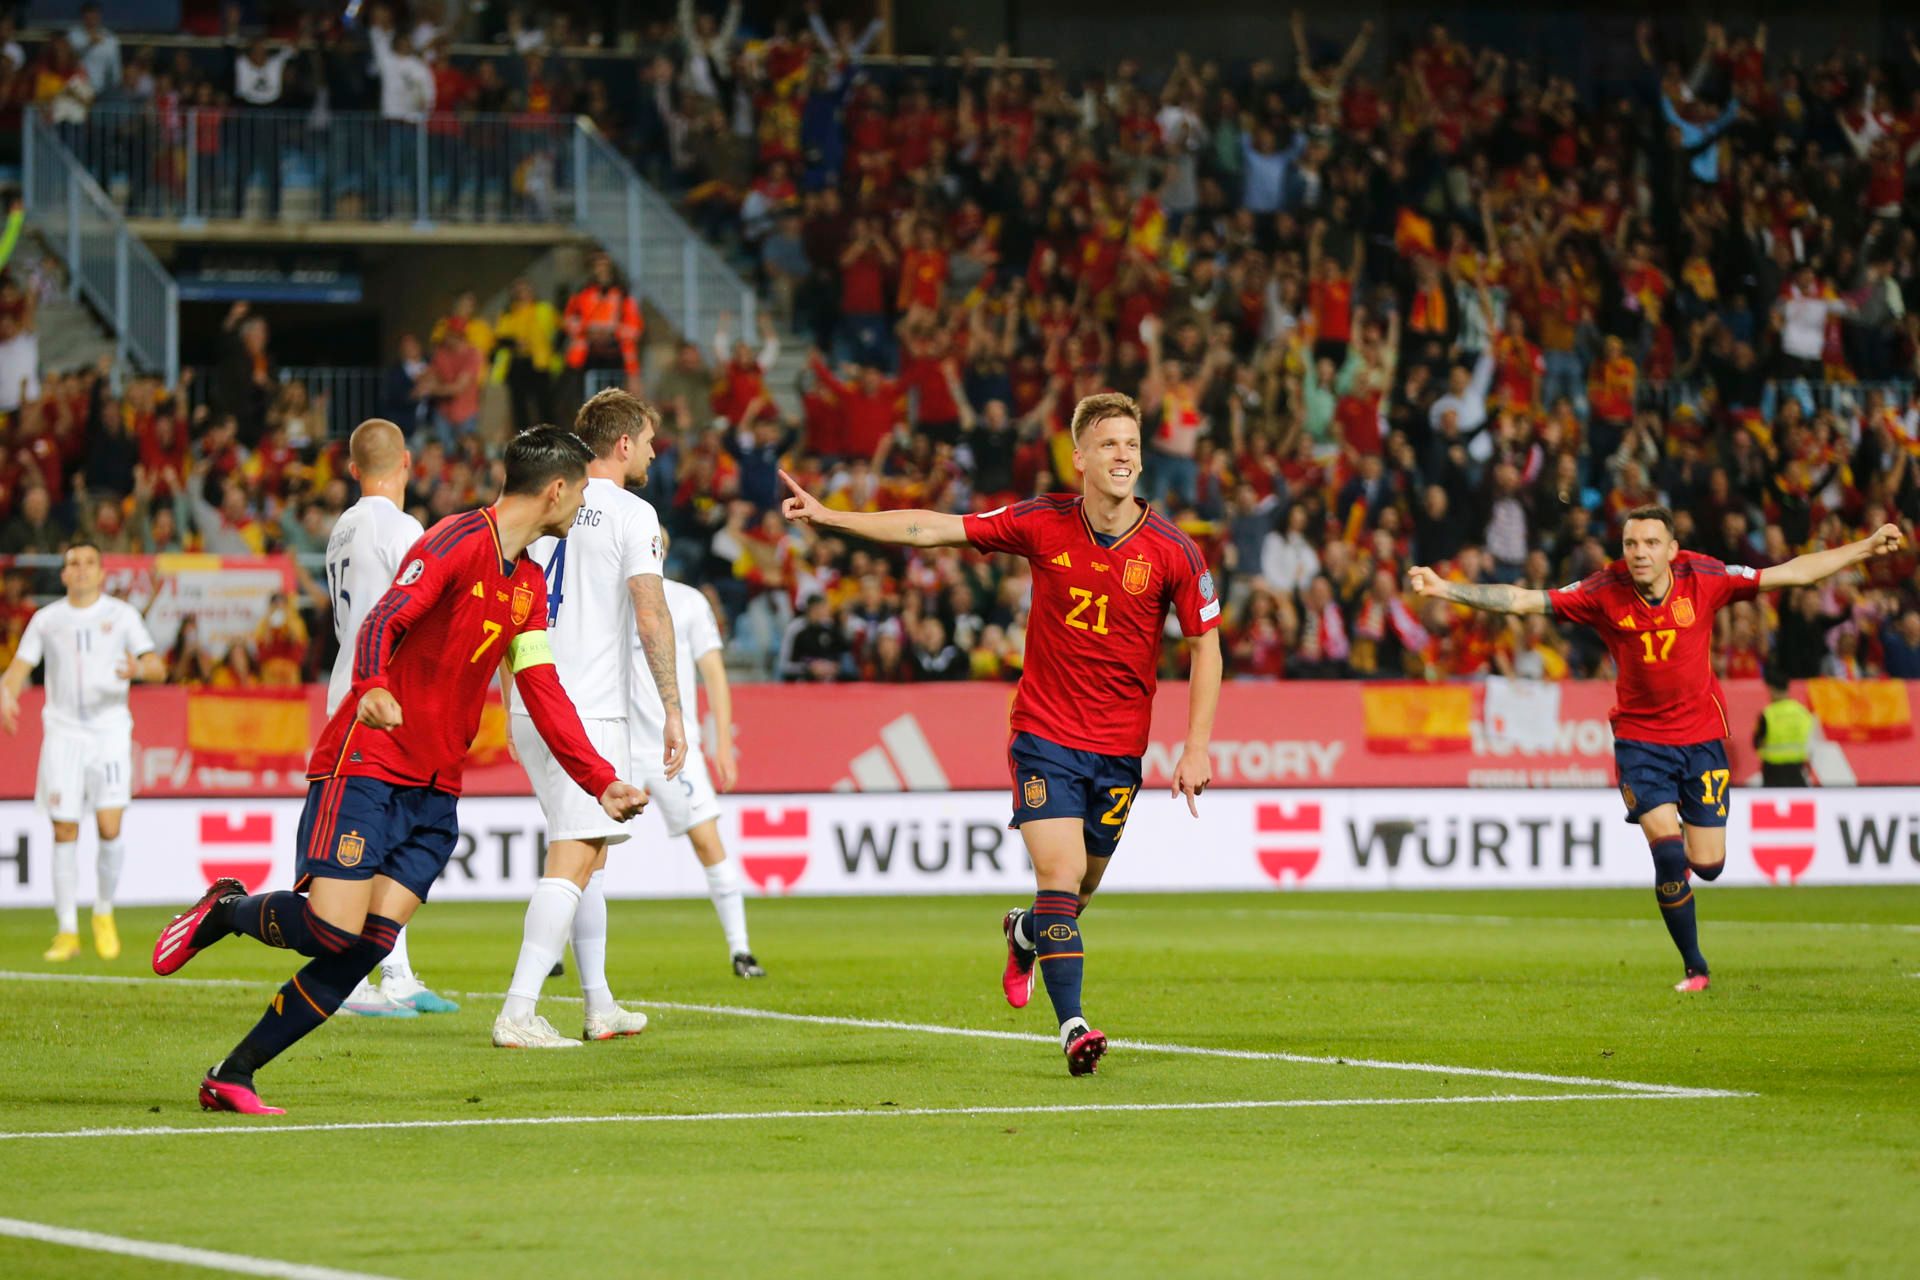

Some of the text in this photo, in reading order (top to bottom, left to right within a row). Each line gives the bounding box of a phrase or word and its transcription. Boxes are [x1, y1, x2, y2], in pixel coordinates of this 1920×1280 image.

[571, 508, 602, 527] ERG
[329, 558, 351, 628] 15
[544, 539, 566, 628] 4
[1065, 586, 1109, 635] 21
[76, 628, 91, 652] 11
[470, 619, 502, 663] 7
[1640, 629, 1677, 664] 17
[105, 761, 120, 784] 11
[1701, 769, 1730, 804] 17
[834, 823, 1033, 873] WÜR
[1346, 816, 1603, 867] WÜRTH
